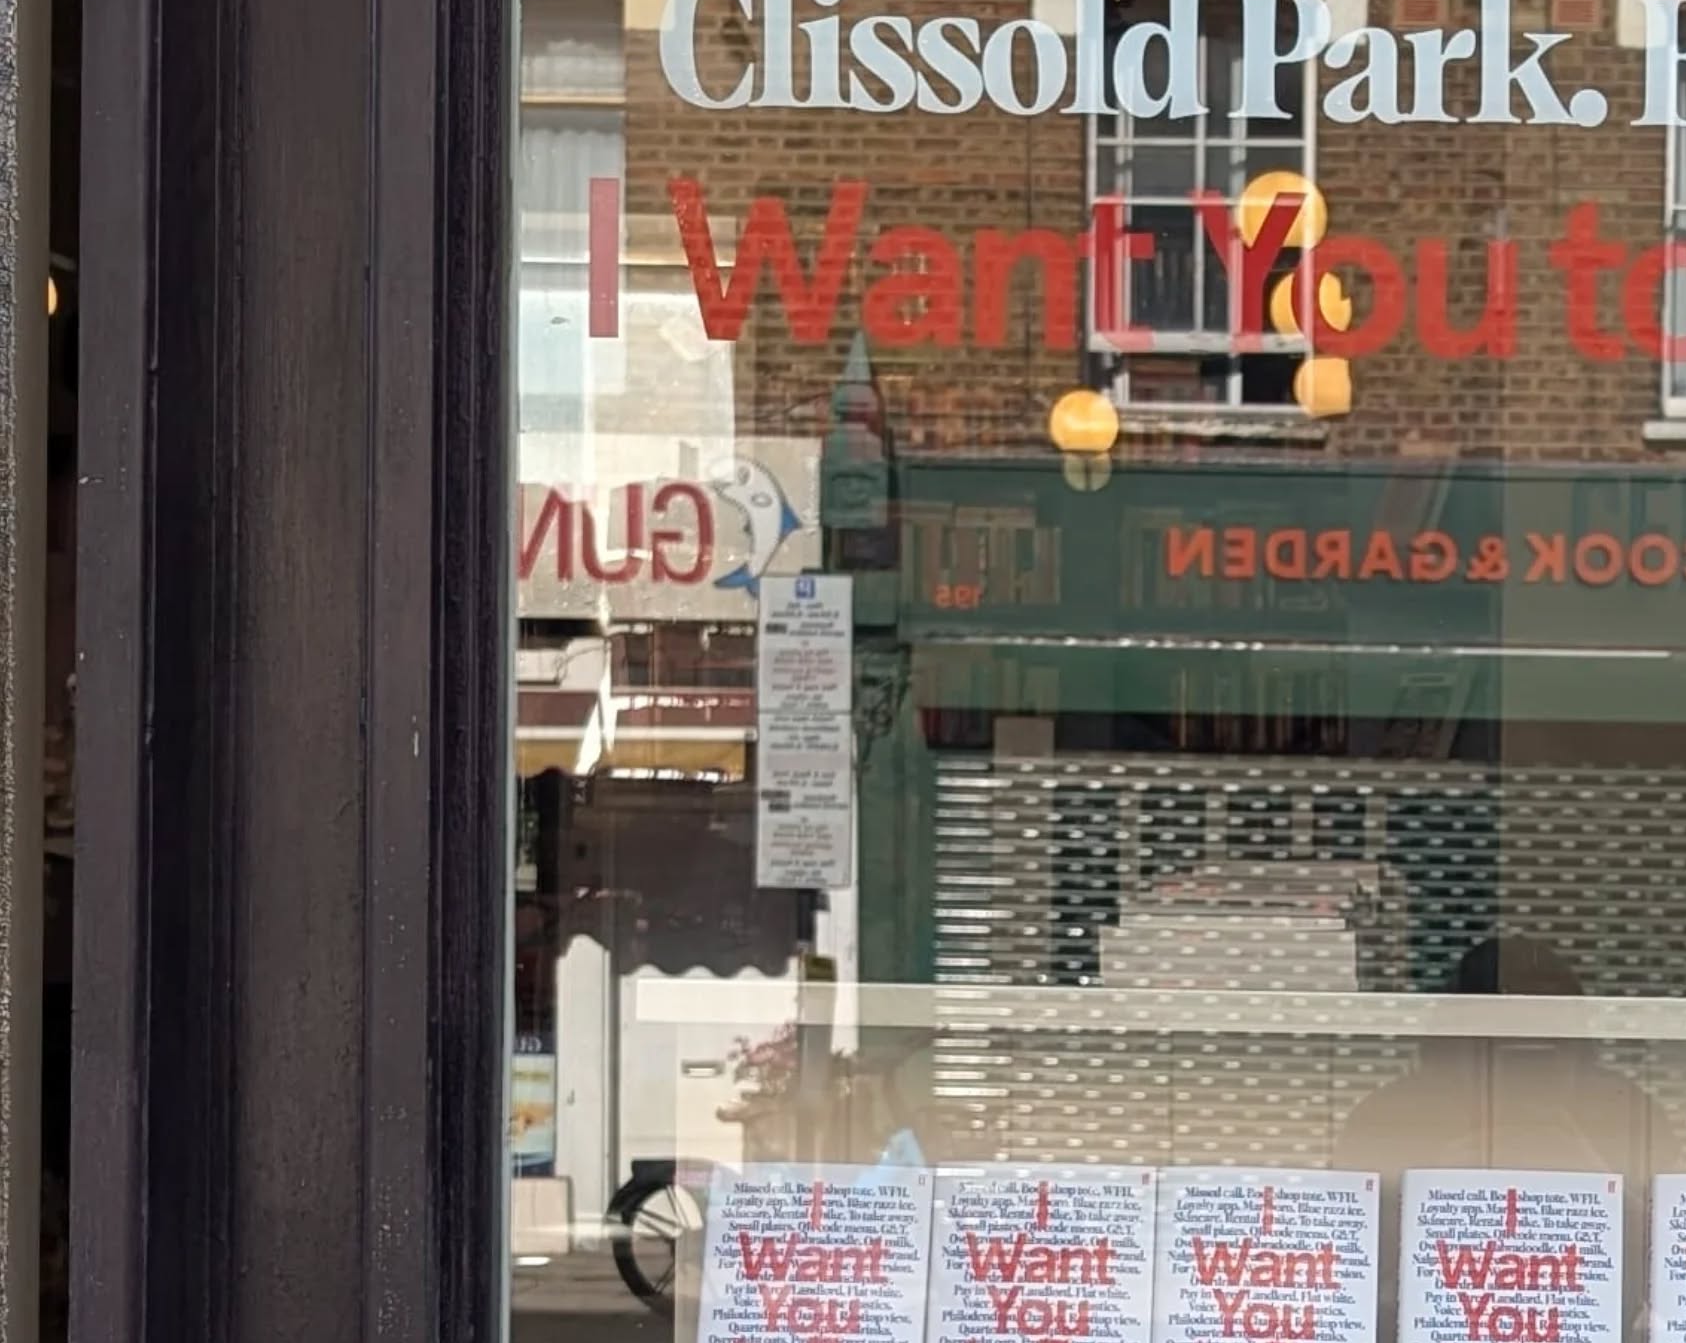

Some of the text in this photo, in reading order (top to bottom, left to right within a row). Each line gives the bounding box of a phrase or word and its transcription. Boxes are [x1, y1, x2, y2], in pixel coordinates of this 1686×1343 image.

[589, 178, 619, 339] I
[669, 180, 1155, 353] Want
[1195, 190, 1518, 361] You
[814, 1181, 825, 1229] I
[1038, 1181, 1049, 1228] I
[1506, 1189, 1518, 1237] I
[739, 1231, 893, 1285] Want
[967, 1231, 1118, 1286] Want
[1436, 1240, 1587, 1293] Want
[758, 1284, 862, 1335] You
[985, 1284, 1090, 1337] You
[1455, 1293, 1559, 1343] You
